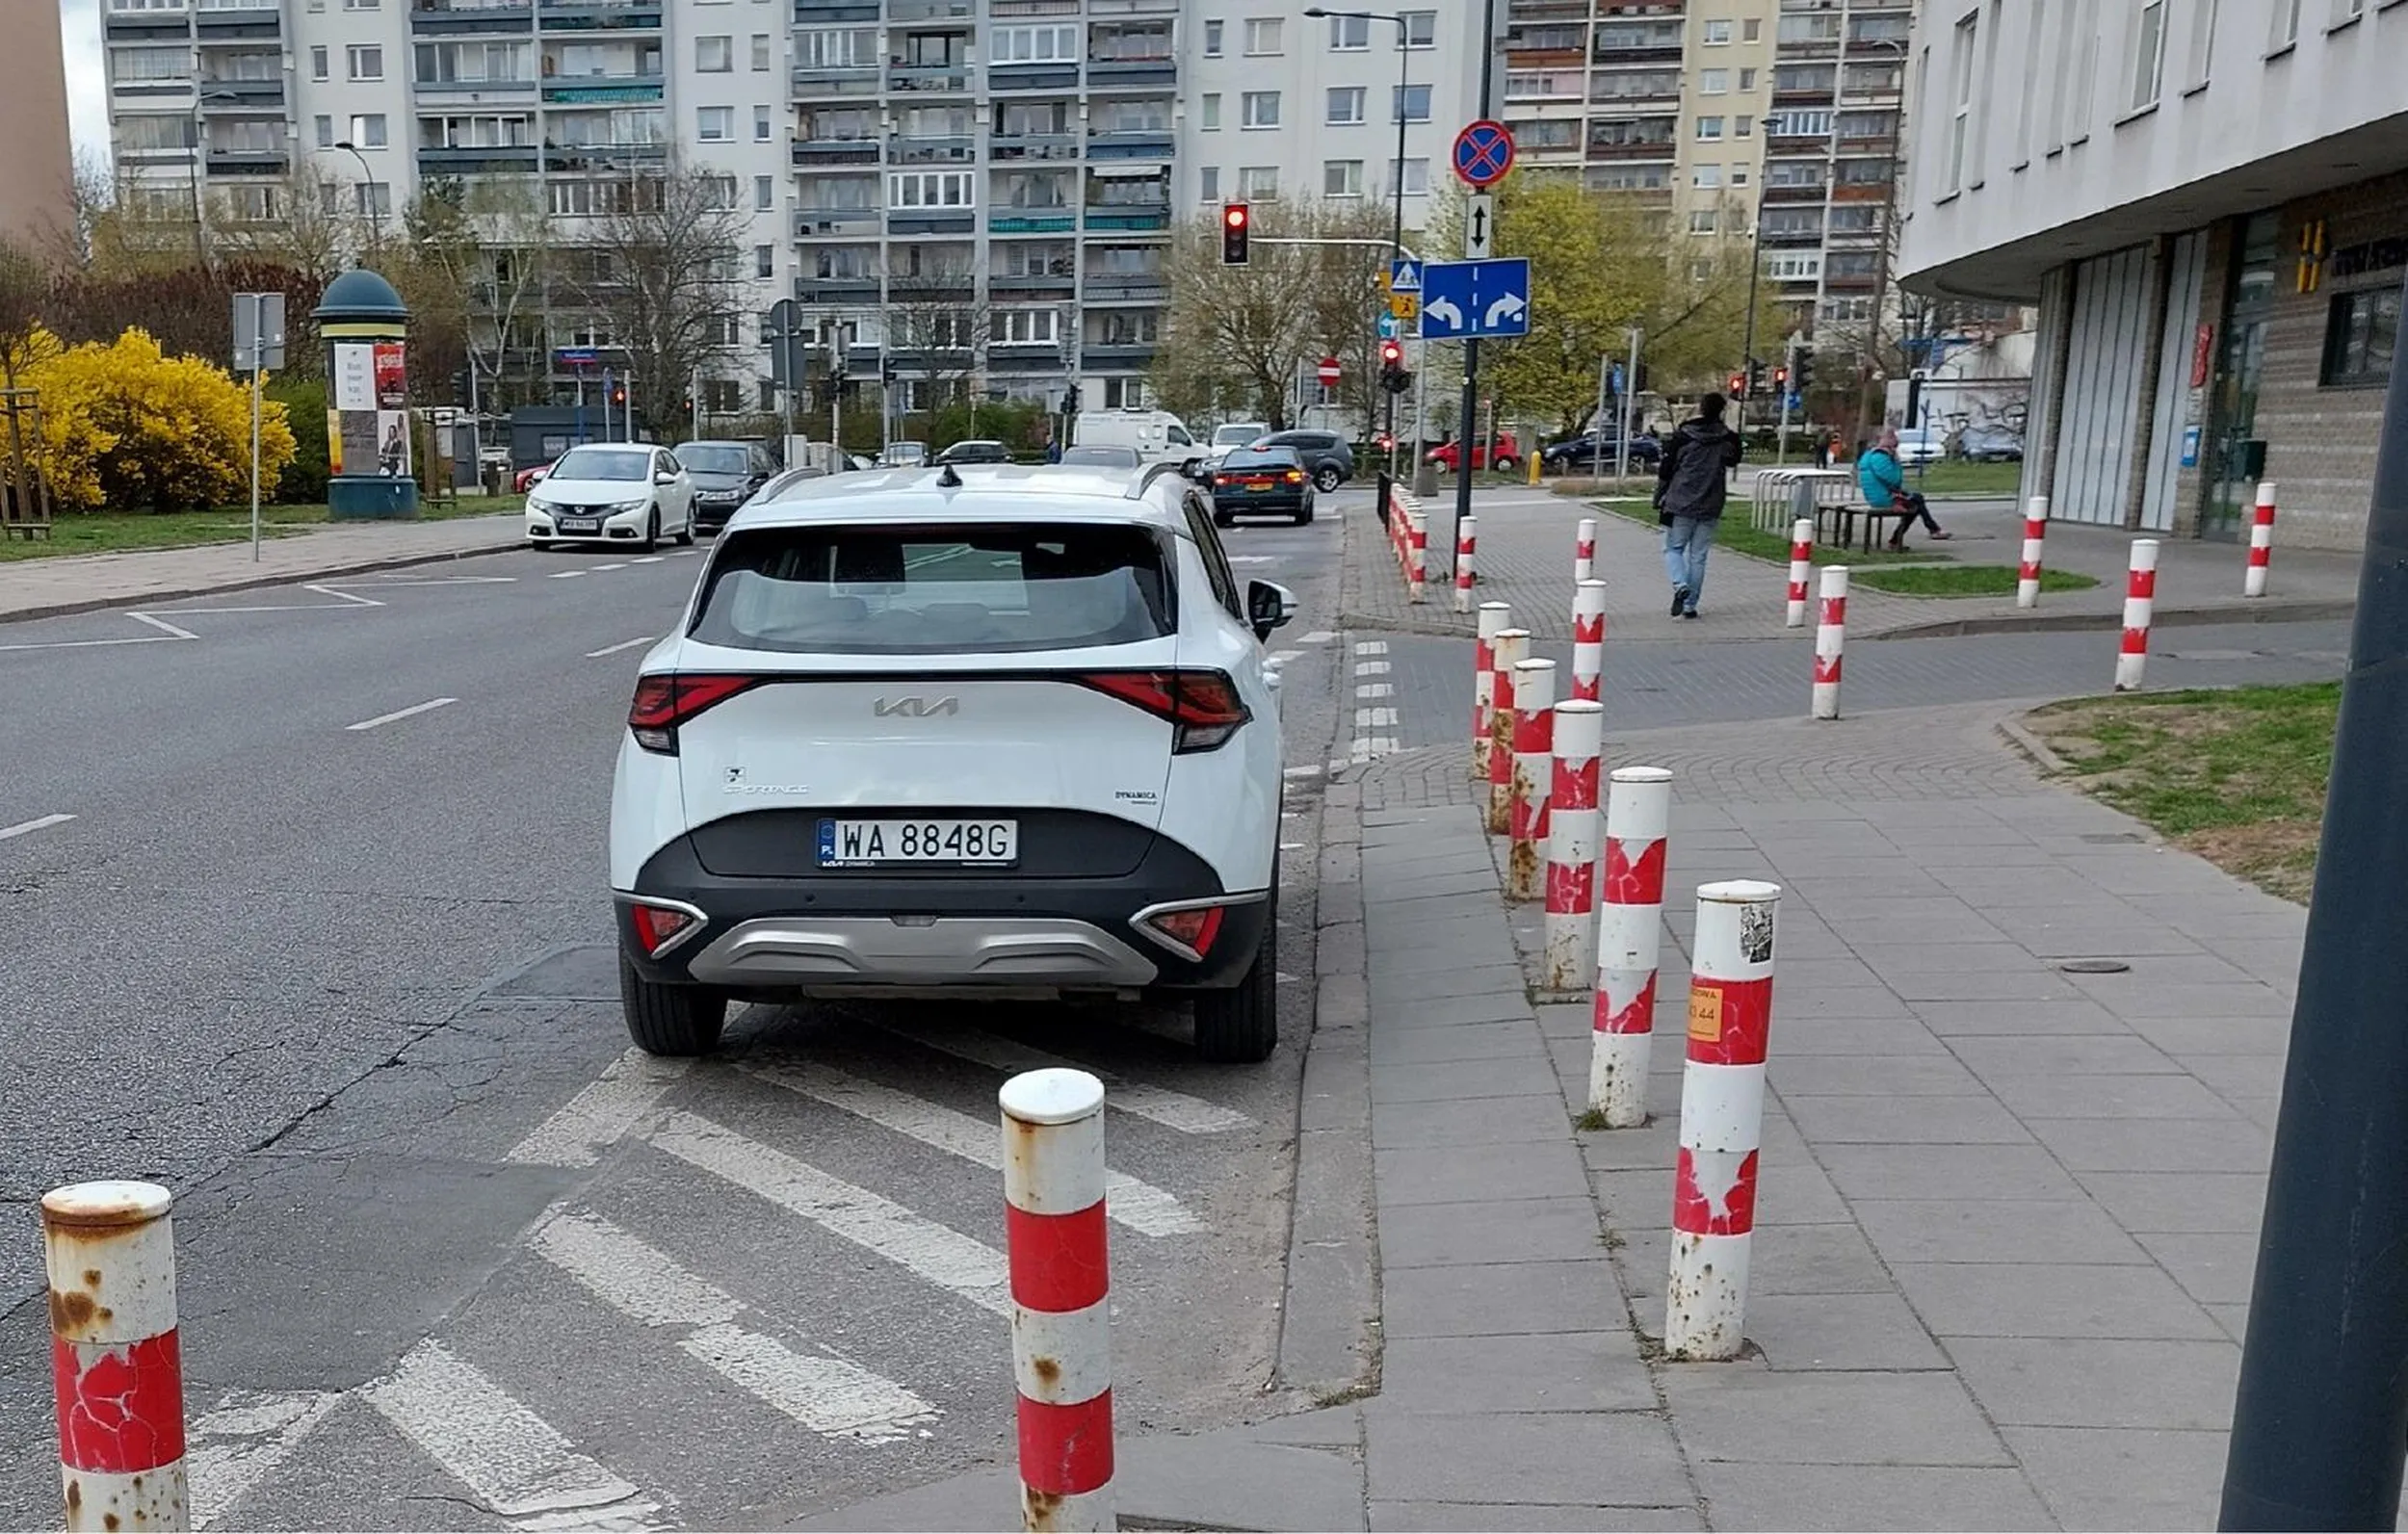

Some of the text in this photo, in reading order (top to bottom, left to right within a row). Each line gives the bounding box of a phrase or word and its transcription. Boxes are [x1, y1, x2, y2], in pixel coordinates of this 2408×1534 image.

[874, 695, 959, 717] KIA
[822, 845, 834, 855] PL
[843, 823, 1008, 857] WA 8848G
